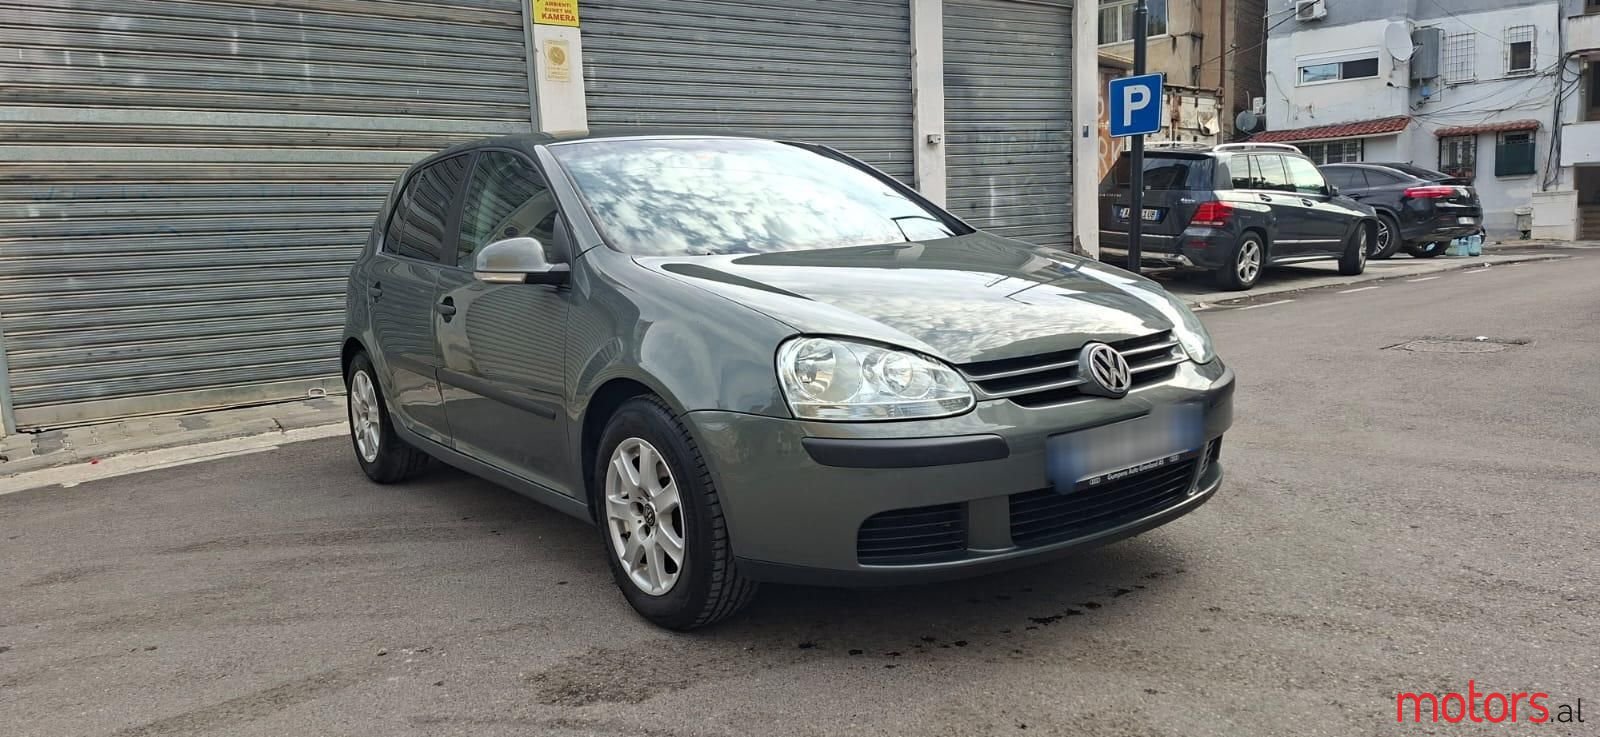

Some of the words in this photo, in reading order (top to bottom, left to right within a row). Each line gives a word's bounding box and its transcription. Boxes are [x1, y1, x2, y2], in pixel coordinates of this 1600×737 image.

[541, 12, 576, 21] KAMERA
[1123, 85, 1152, 127] P
[1092, 345, 1130, 390] VW
